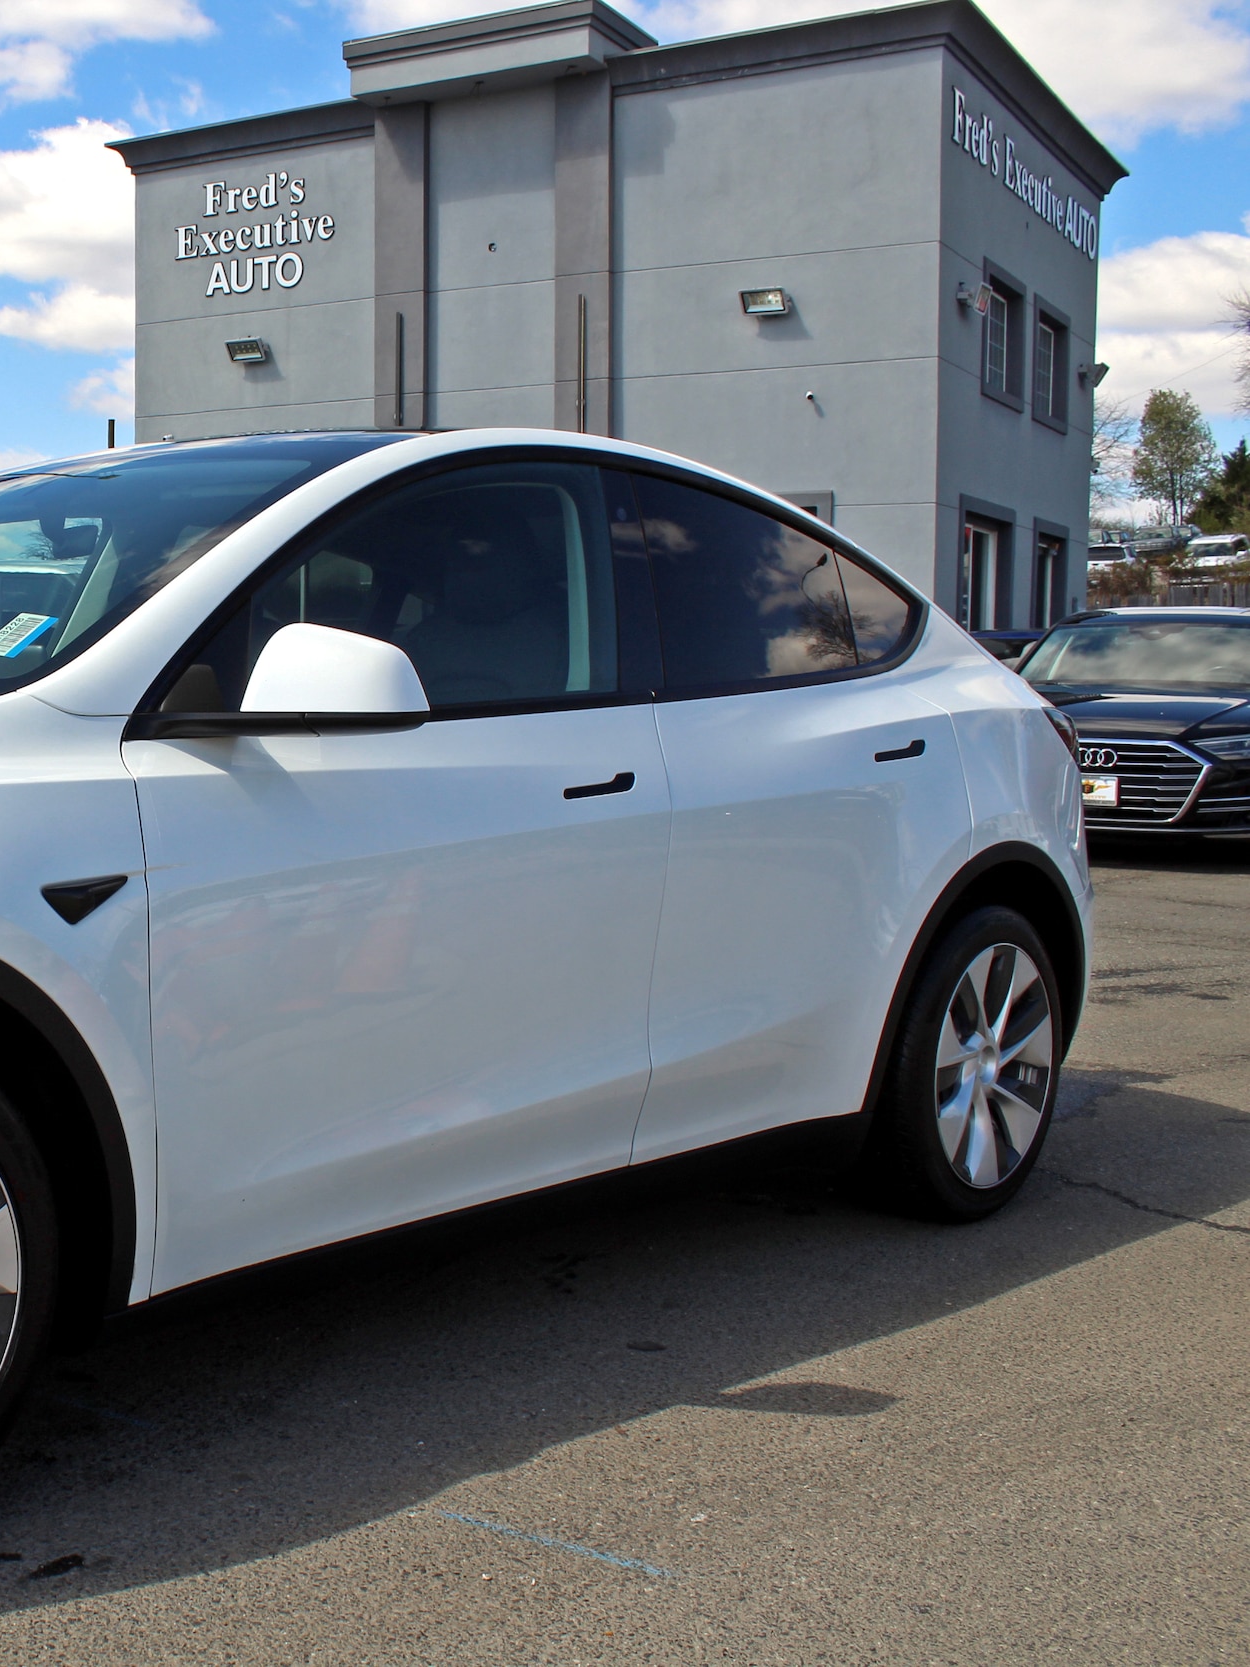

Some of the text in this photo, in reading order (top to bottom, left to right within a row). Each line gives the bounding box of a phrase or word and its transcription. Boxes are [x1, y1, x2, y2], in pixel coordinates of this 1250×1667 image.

[202, 171, 306, 217] Fred's
[952, 86, 1098, 261] Fred's Executive AUTO
[175, 209, 335, 260] Executive
[205, 252, 304, 297] AUTO
